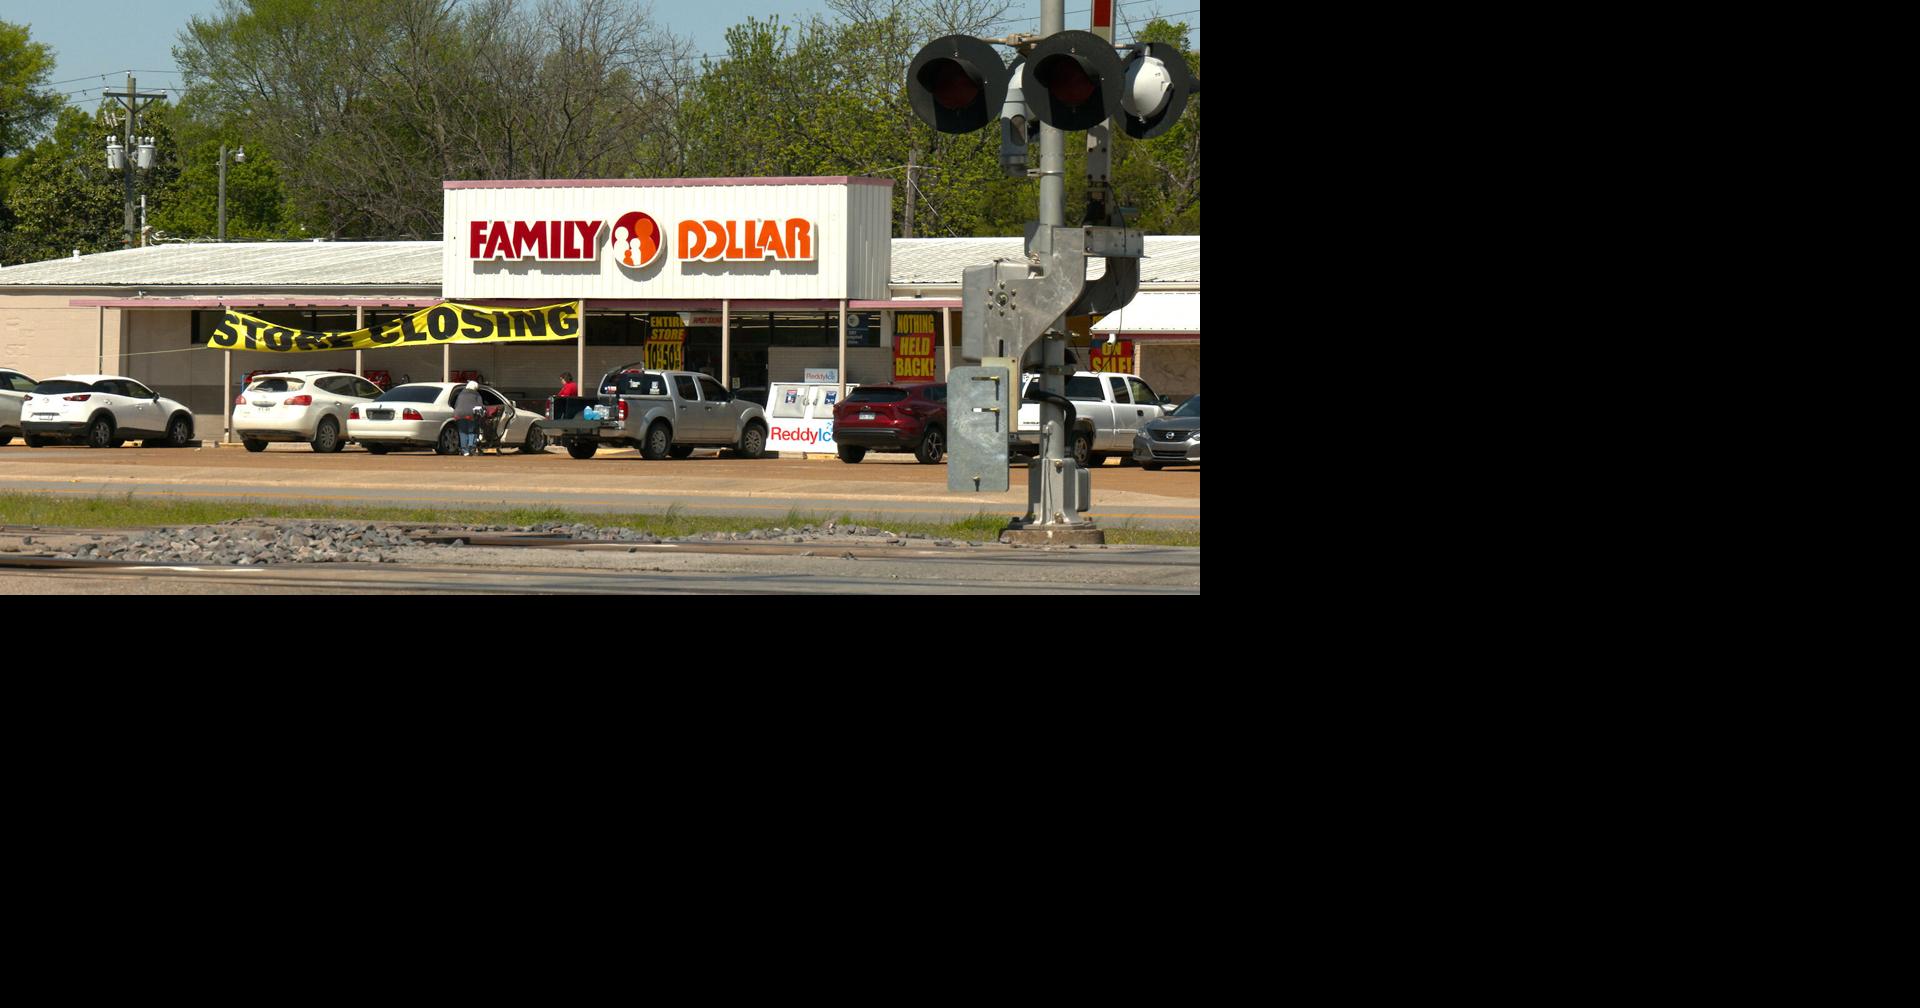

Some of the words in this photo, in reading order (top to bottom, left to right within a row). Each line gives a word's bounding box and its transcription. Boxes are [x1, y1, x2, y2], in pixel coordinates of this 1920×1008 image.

[470, 220, 602, 259] FAMILY
[678, 218, 812, 259] DOLLAR
[370, 305, 579, 343] CLOSING
[897, 314, 934, 334] NOTHING
[651, 329, 685, 340] STORE
[900, 337, 930, 355] HELD
[1101, 341, 1121, 355] ON
[896, 358, 934, 376] BACK!
[771, 427, 832, 444] ReddyIc
